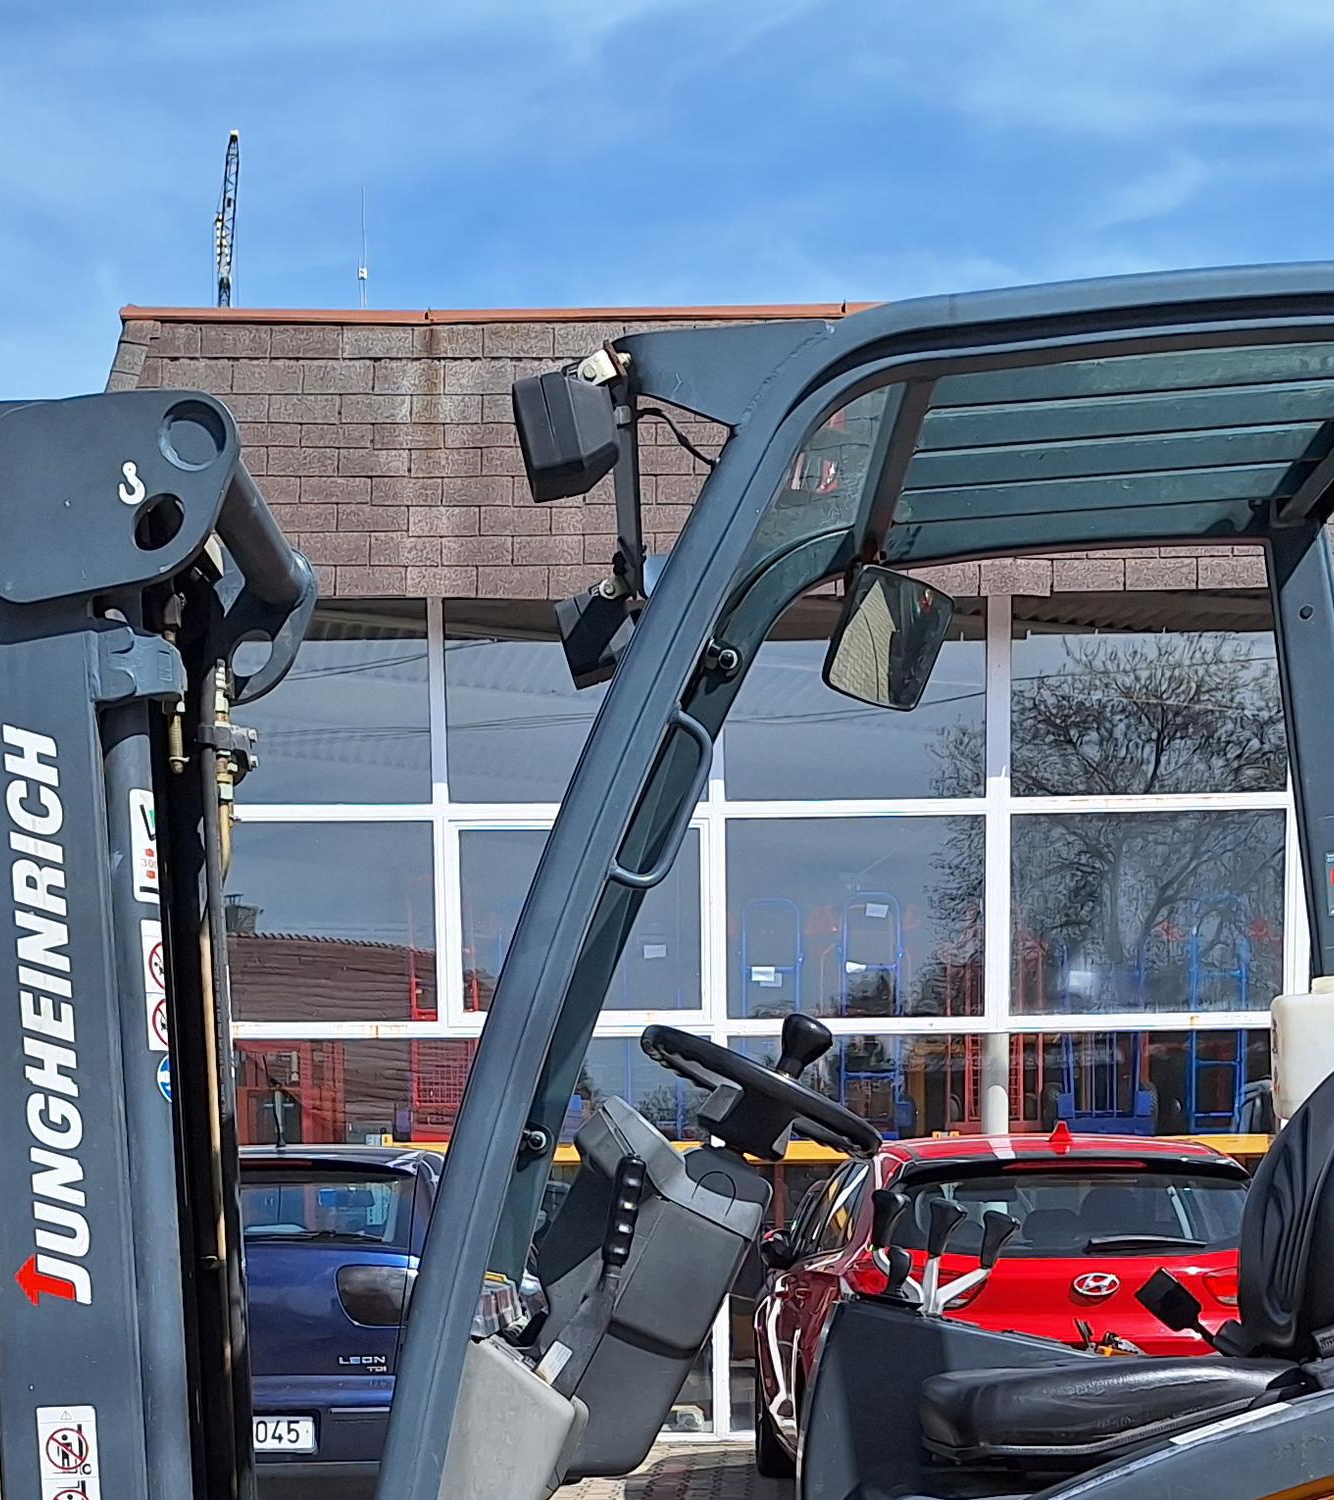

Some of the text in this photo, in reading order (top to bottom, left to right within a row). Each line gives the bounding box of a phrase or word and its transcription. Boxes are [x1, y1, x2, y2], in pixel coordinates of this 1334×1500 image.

[1, 722, 93, 1306] JUNGHEINRICH
[339, 1356, 386, 1365] LEON
[255, 1420, 301, 1444] 045
